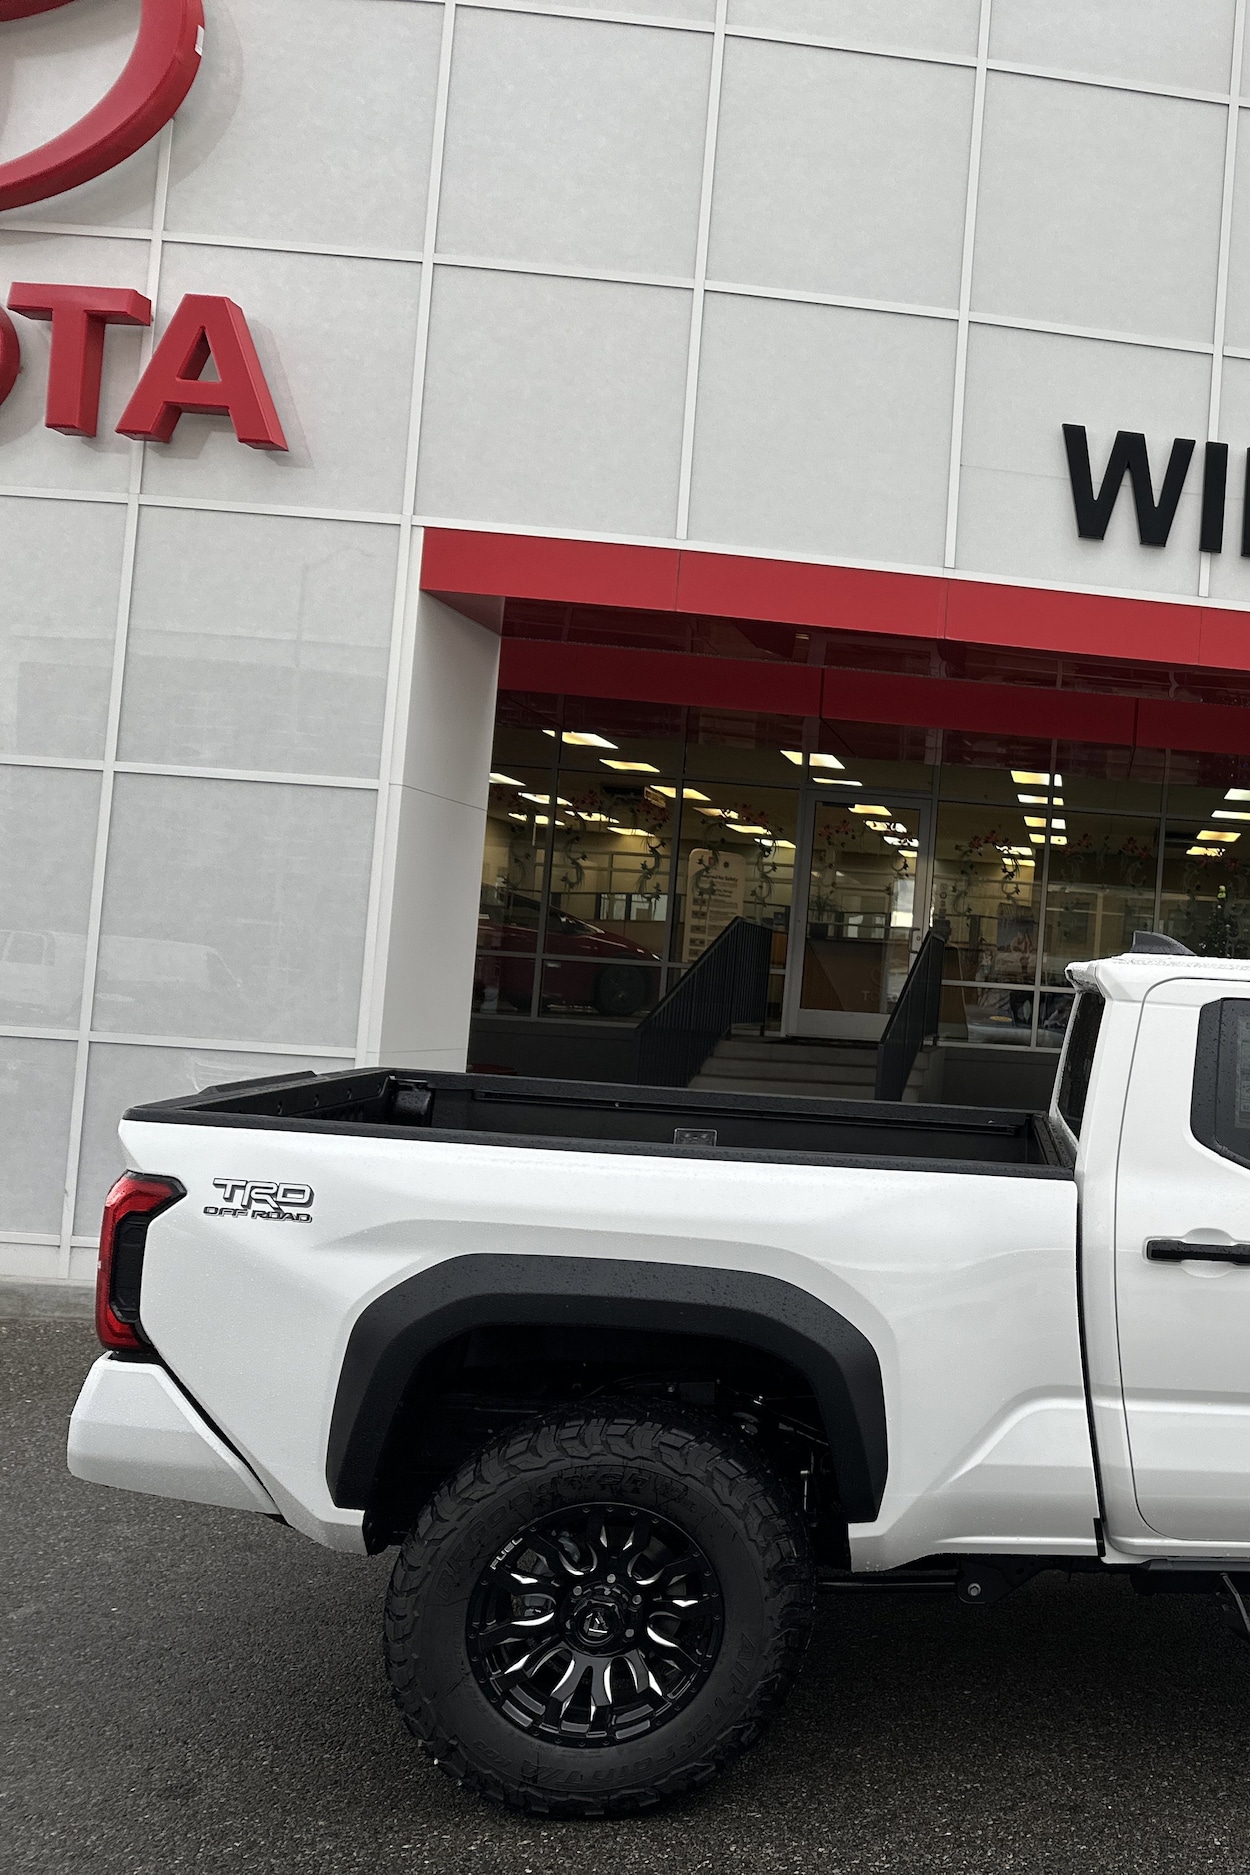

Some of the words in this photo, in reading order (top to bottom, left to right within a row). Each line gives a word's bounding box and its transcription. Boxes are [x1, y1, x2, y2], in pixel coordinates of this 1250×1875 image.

[213, 1178, 315, 1211] TRD
[203, 1206, 249, 1218] OFF
[251, 1210, 312, 1224] ROAD
[490, 1538, 523, 1570] FUEL
